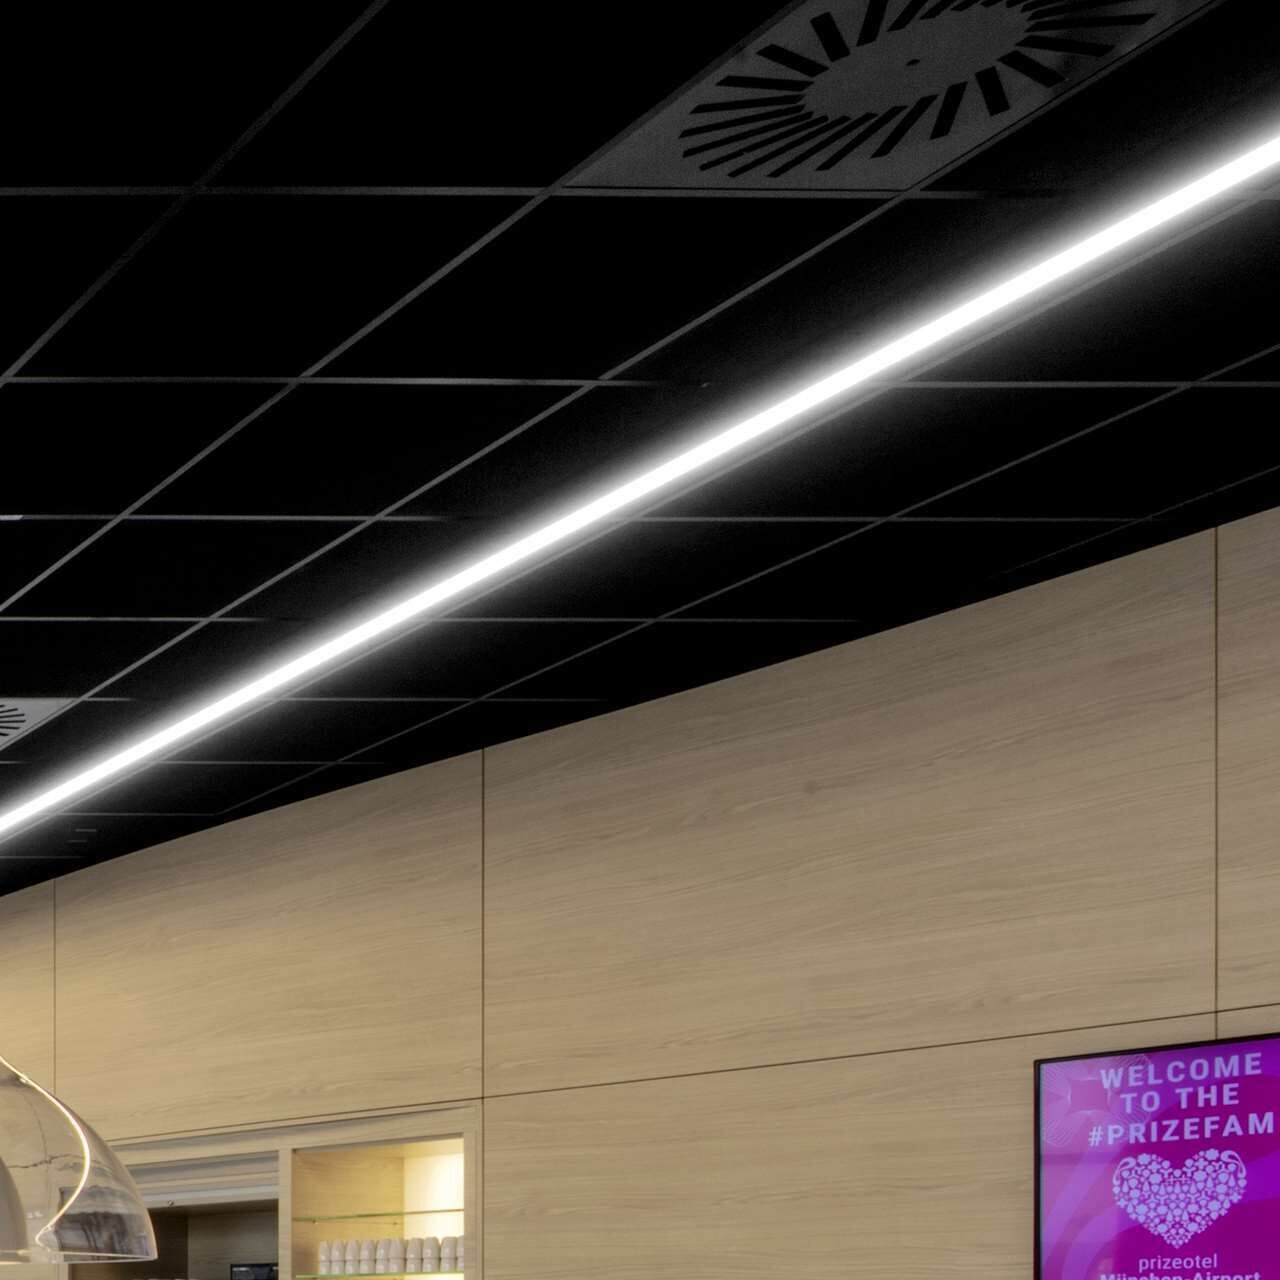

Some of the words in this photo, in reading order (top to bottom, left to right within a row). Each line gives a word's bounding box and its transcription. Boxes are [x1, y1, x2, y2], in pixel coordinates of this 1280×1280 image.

[1100, 1052, 1262, 1089] WELCOME
[1120, 1091, 1161, 1114] TO
[1175, 1083, 1240, 1110] THE
[1088, 1111, 1274, 1147] #PRIZEFAM
[1138, 1253, 1218, 1274] prizeotel
